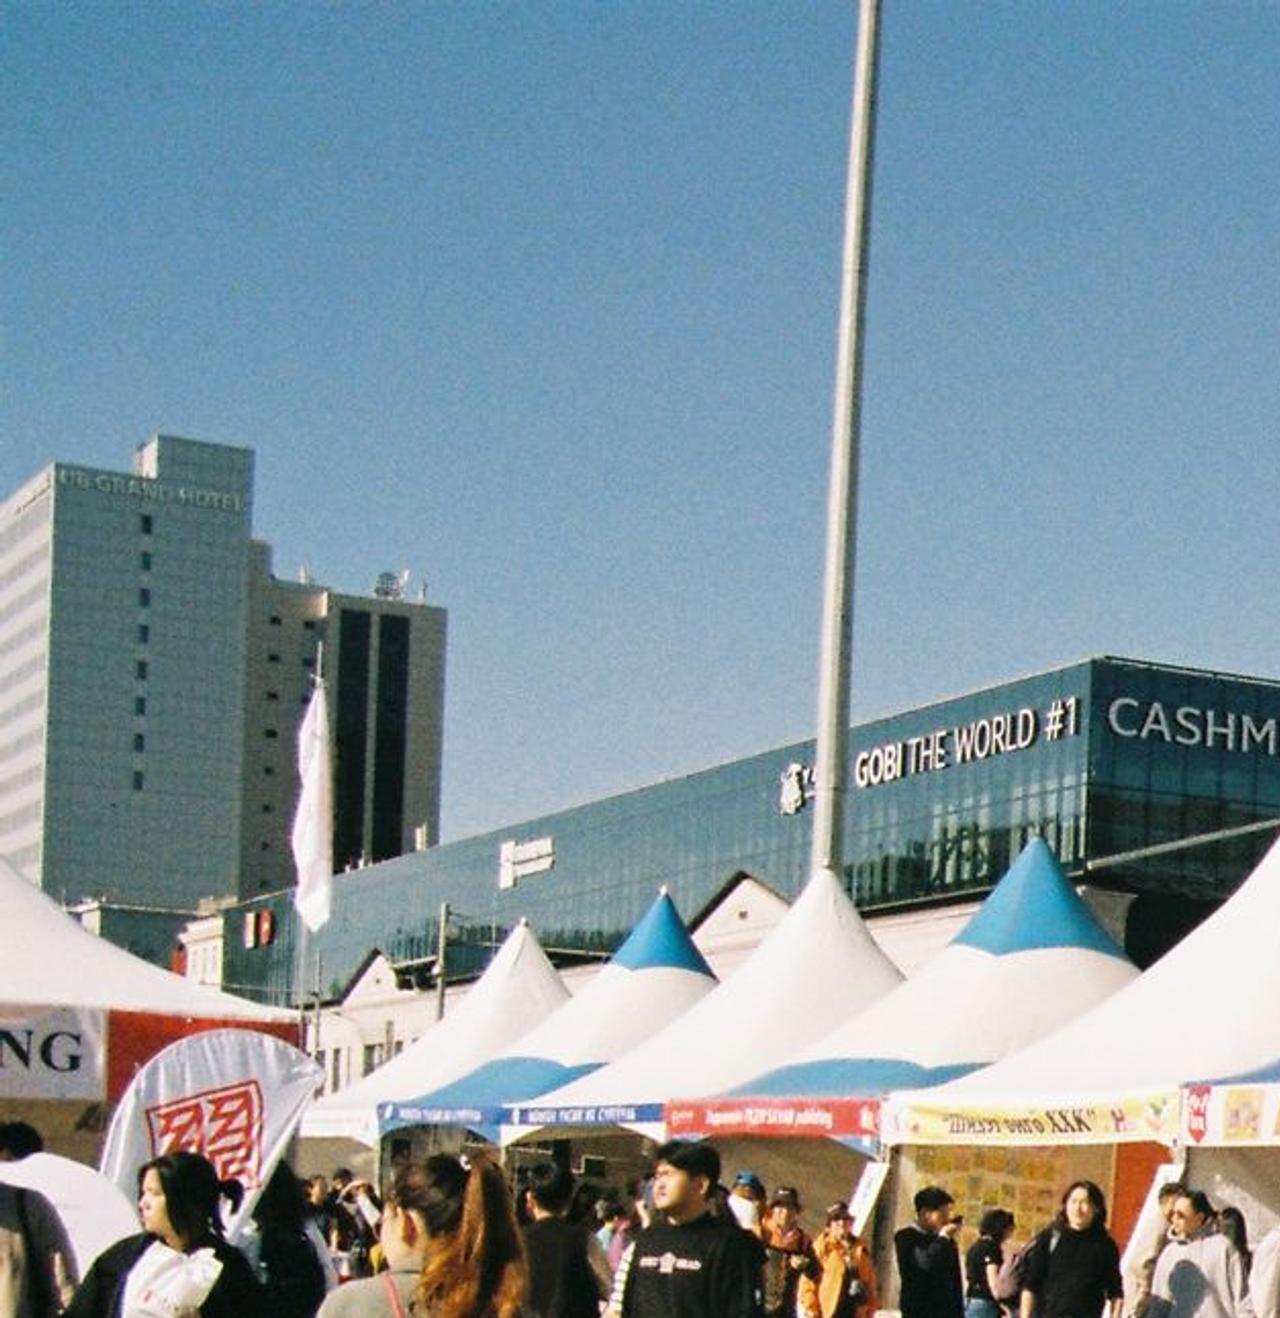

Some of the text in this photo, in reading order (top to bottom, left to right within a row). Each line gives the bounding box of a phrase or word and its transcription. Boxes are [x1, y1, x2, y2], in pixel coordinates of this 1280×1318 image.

[179, 486, 242, 512] HOTEL
[855, 743, 903, 788] GOBI
[908, 731, 948, 774] THE
[954, 709, 1033, 764] WORLD
[1044, 697, 1078, 742] #1
